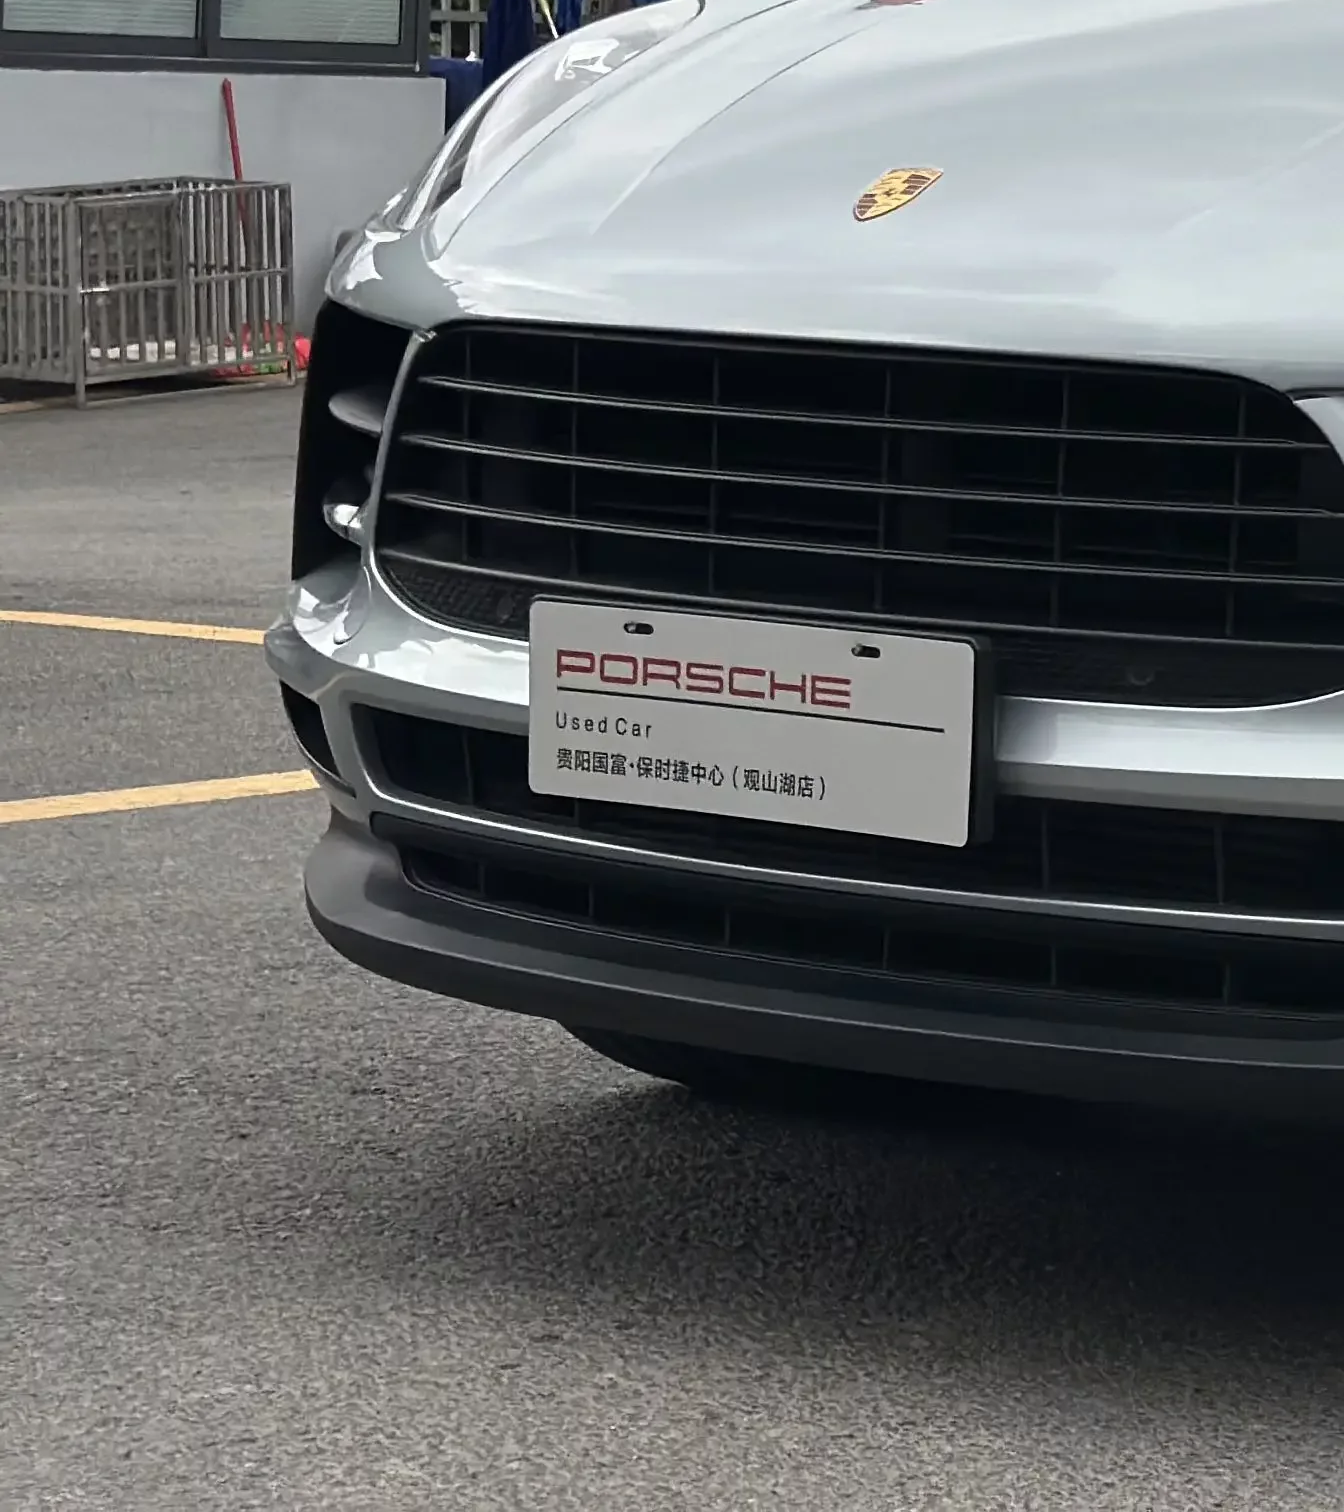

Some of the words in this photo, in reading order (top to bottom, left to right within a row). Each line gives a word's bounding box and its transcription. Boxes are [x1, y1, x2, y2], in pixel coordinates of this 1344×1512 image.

[556, 649, 852, 709] PORSCHE
[556, 710, 608, 734] Used
[615, 717, 652, 739] Car
